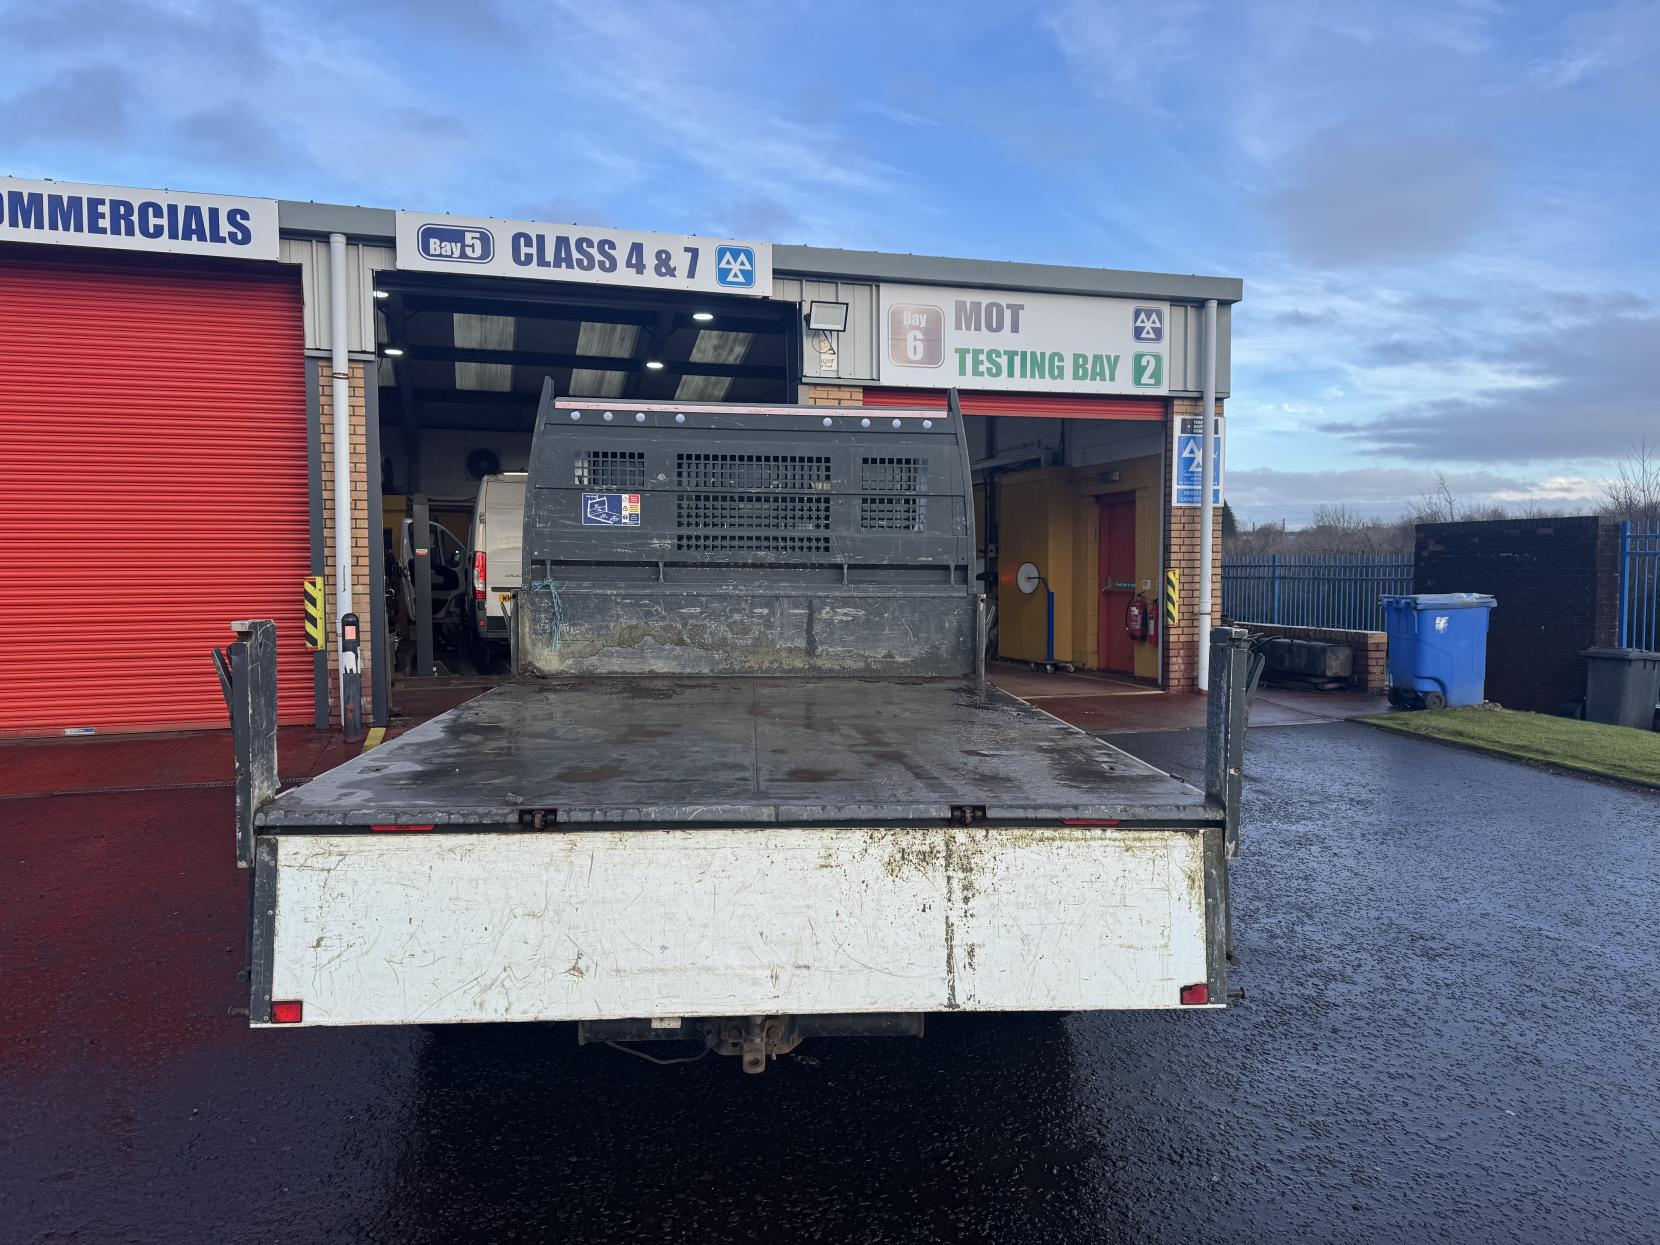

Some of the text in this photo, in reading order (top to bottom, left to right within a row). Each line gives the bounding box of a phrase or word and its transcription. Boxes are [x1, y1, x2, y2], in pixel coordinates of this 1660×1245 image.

[0, 190, 252, 246] MMERCIALS
[429, 232, 482, 258] Bay 5
[511, 232, 700, 280] CLASS 4 & 7
[903, 310, 927, 328] Bay
[954, 300, 1025, 334] MOT
[906, 330, 924, 361] 6
[954, 347, 1121, 382] TESTING BAY
[1141, 356, 1156, 385] 2
